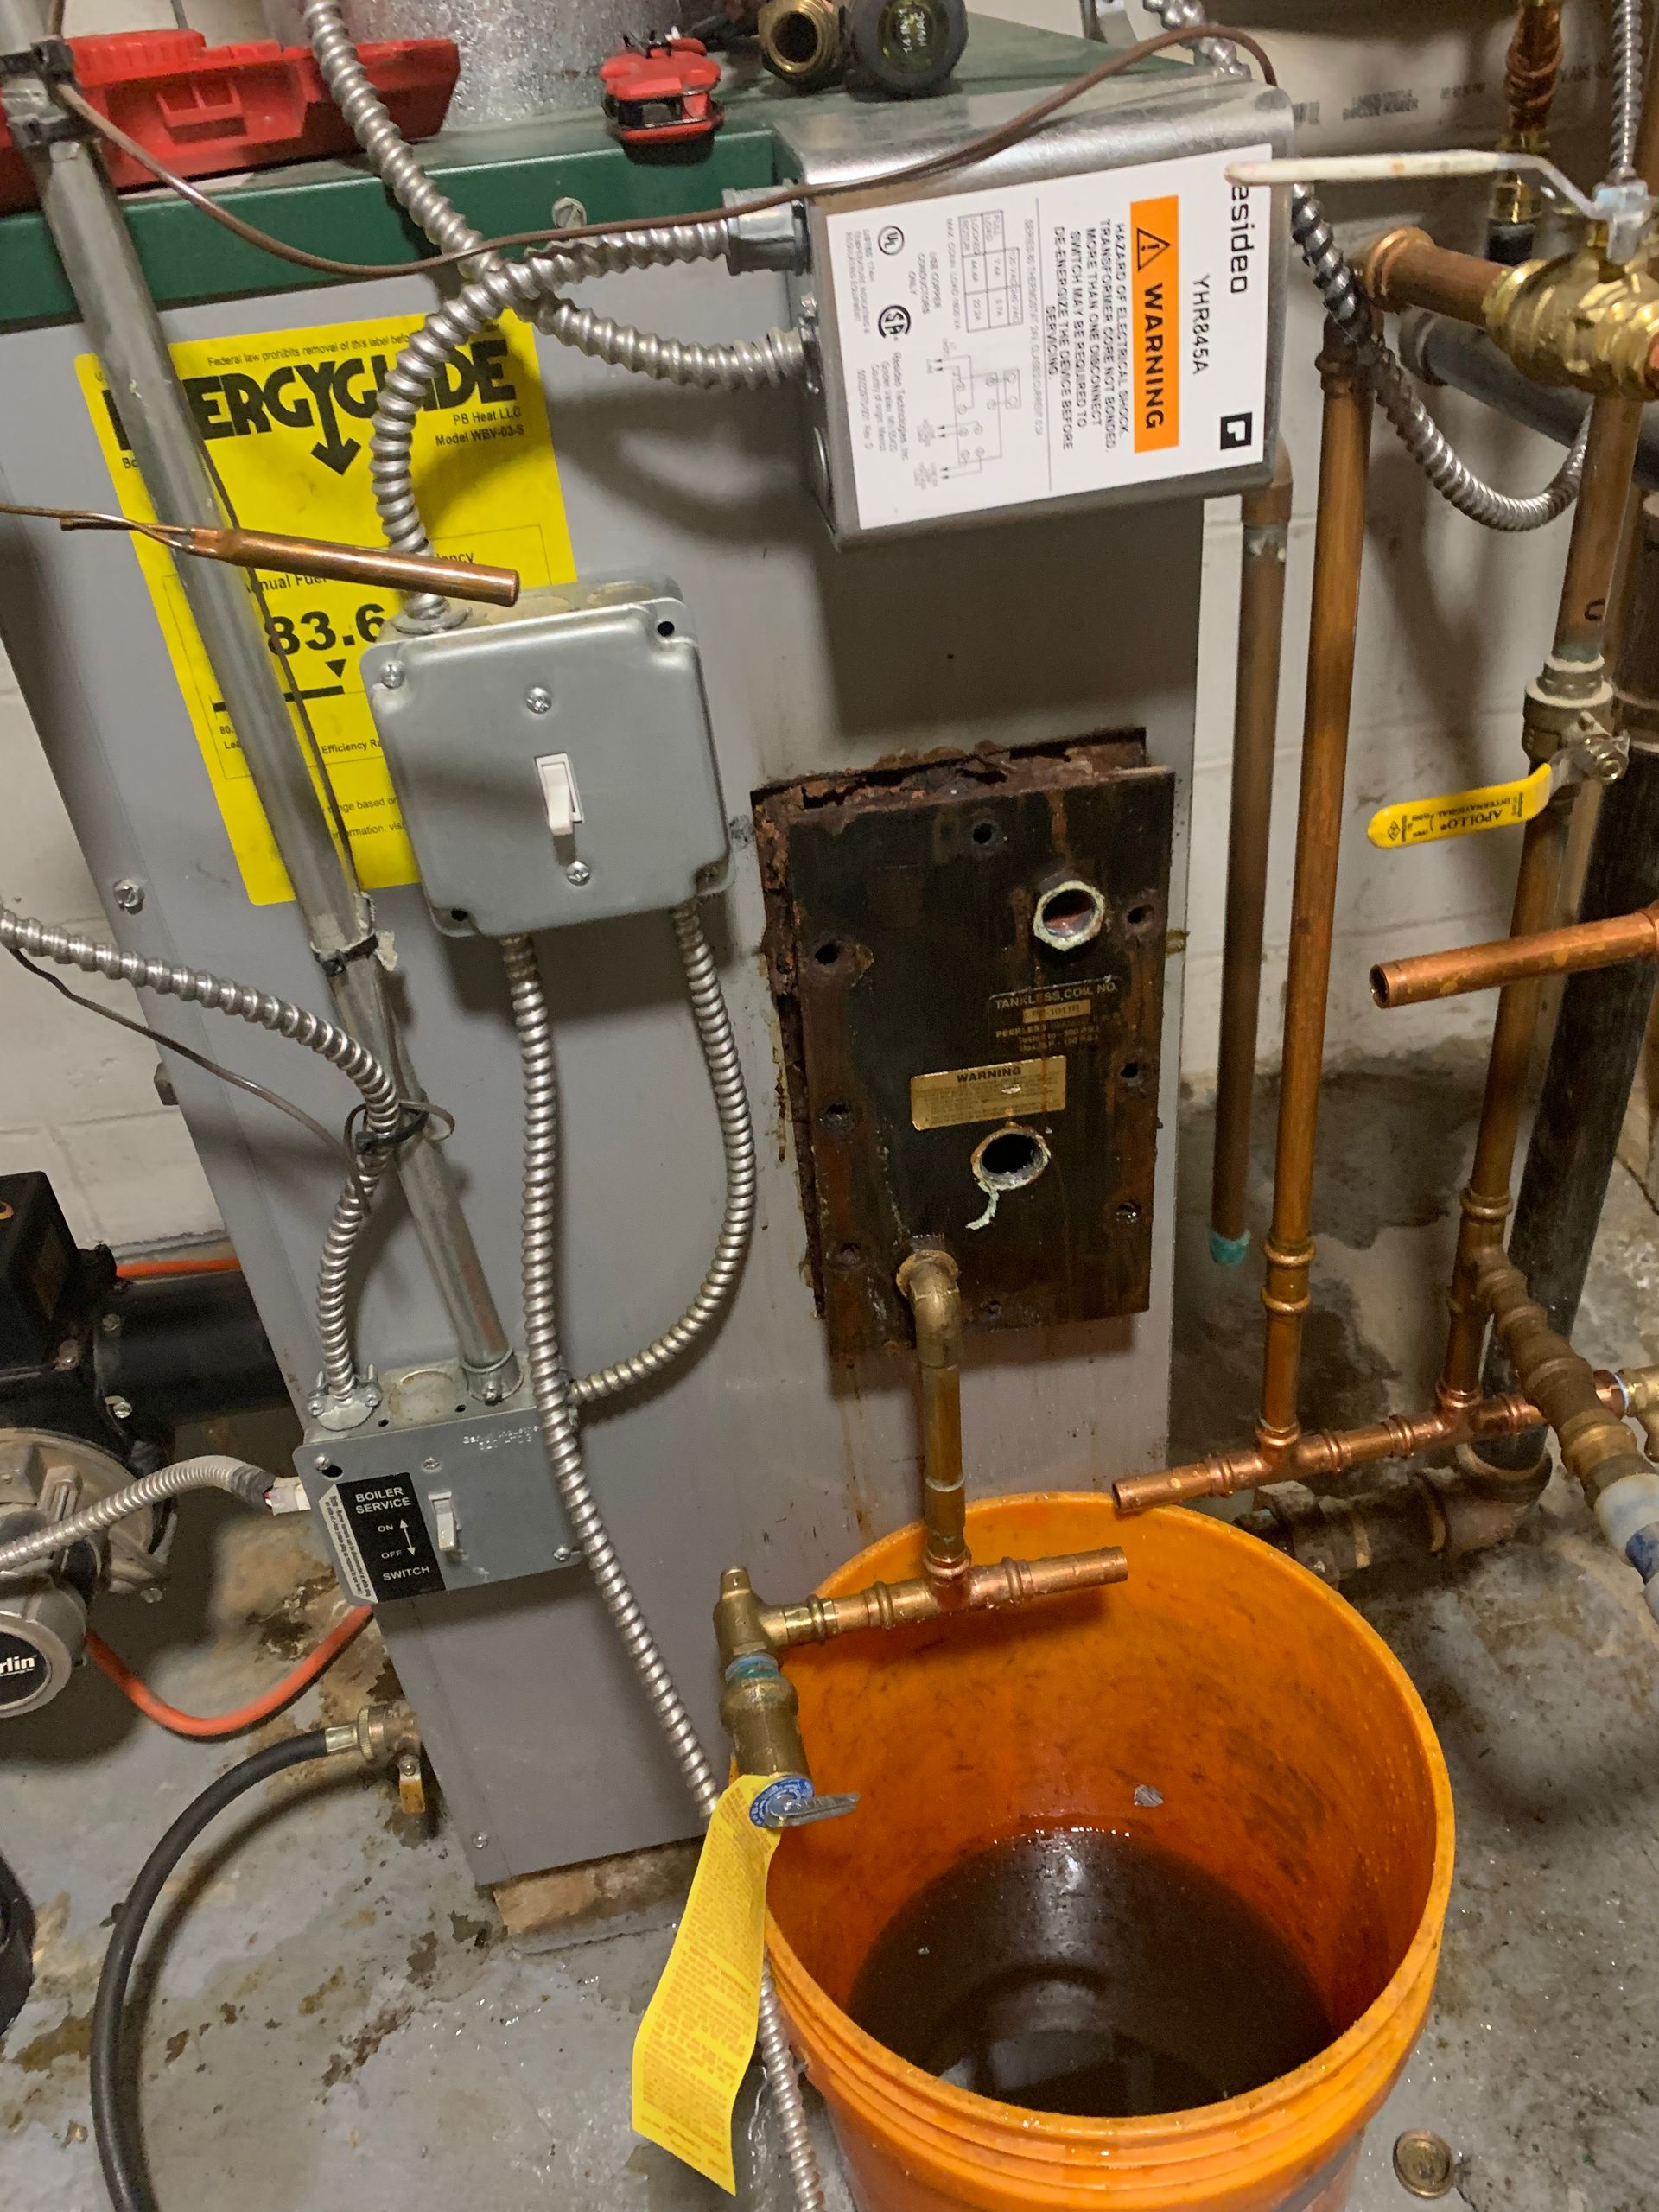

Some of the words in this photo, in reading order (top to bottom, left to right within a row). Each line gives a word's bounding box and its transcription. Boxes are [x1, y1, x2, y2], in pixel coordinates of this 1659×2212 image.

[1085, 227, 1097, 270] MORE
[1114, 222, 1126, 282] HAZARD
[1230, 182, 1255, 295] esideo
[1053, 225, 1068, 318] DE-ENERGIZE
[1070, 230, 1082, 284] SWITCH
[1099, 218, 1113, 322] TRANSFORMER
[1071, 287, 1084, 317] MAY
[1087, 271, 1098, 310] THAN
[1116, 284, 1126, 303] OF
[1058, 320, 1069, 347] THE
[1073, 319, 1084, 338] BE
[1088, 312, 1099, 341] ONE
[1192, 274, 1209, 375] YHR845A
[207, 353, 242, 366] Federal
[243, 352, 259, 362] law
[261, 347, 300, 362] prohibits
[301, 342, 338, 356] removal
[339, 340, 349, 350] of
[350, 338, 366, 348] this
[368, 335, 389, 346] label
[1103, 326, 1114, 364] CORE
[1116, 306, 1128, 386] ELECTRICAL
[1143, 282, 1164, 429] WARNING
[1058, 349, 1071, 397] DEVICE
[1073, 340, 1086, 409] REQUIRED
[1089, 344, 1102, 427] DISCONNECT
[1103, 365, 1115, 393] NOT
[104, 340, 517, 452] ERGYGDE
[452, 412, 470, 426] PB
[471, 409, 497, 423] Heat
[1060, 398, 1073, 451] BEFORE
[1077, 410, 1087, 429] TO
[434, 431, 469, 447] Model
[264, 603, 386, 657] 83.6
[320, 740, 368, 756] Efficiency
[355, 797, 385, 810] based
[956, 1065, 1020, 1083] WARNING
[354, 1484, 404, 1503] BOILER
[354, 1495, 411, 1516] SERVICE
[376, 1523, 394, 1533] ON
[380, 1548, 403, 1559] OFF
[381, 1564, 430, 1581] SWITCH
